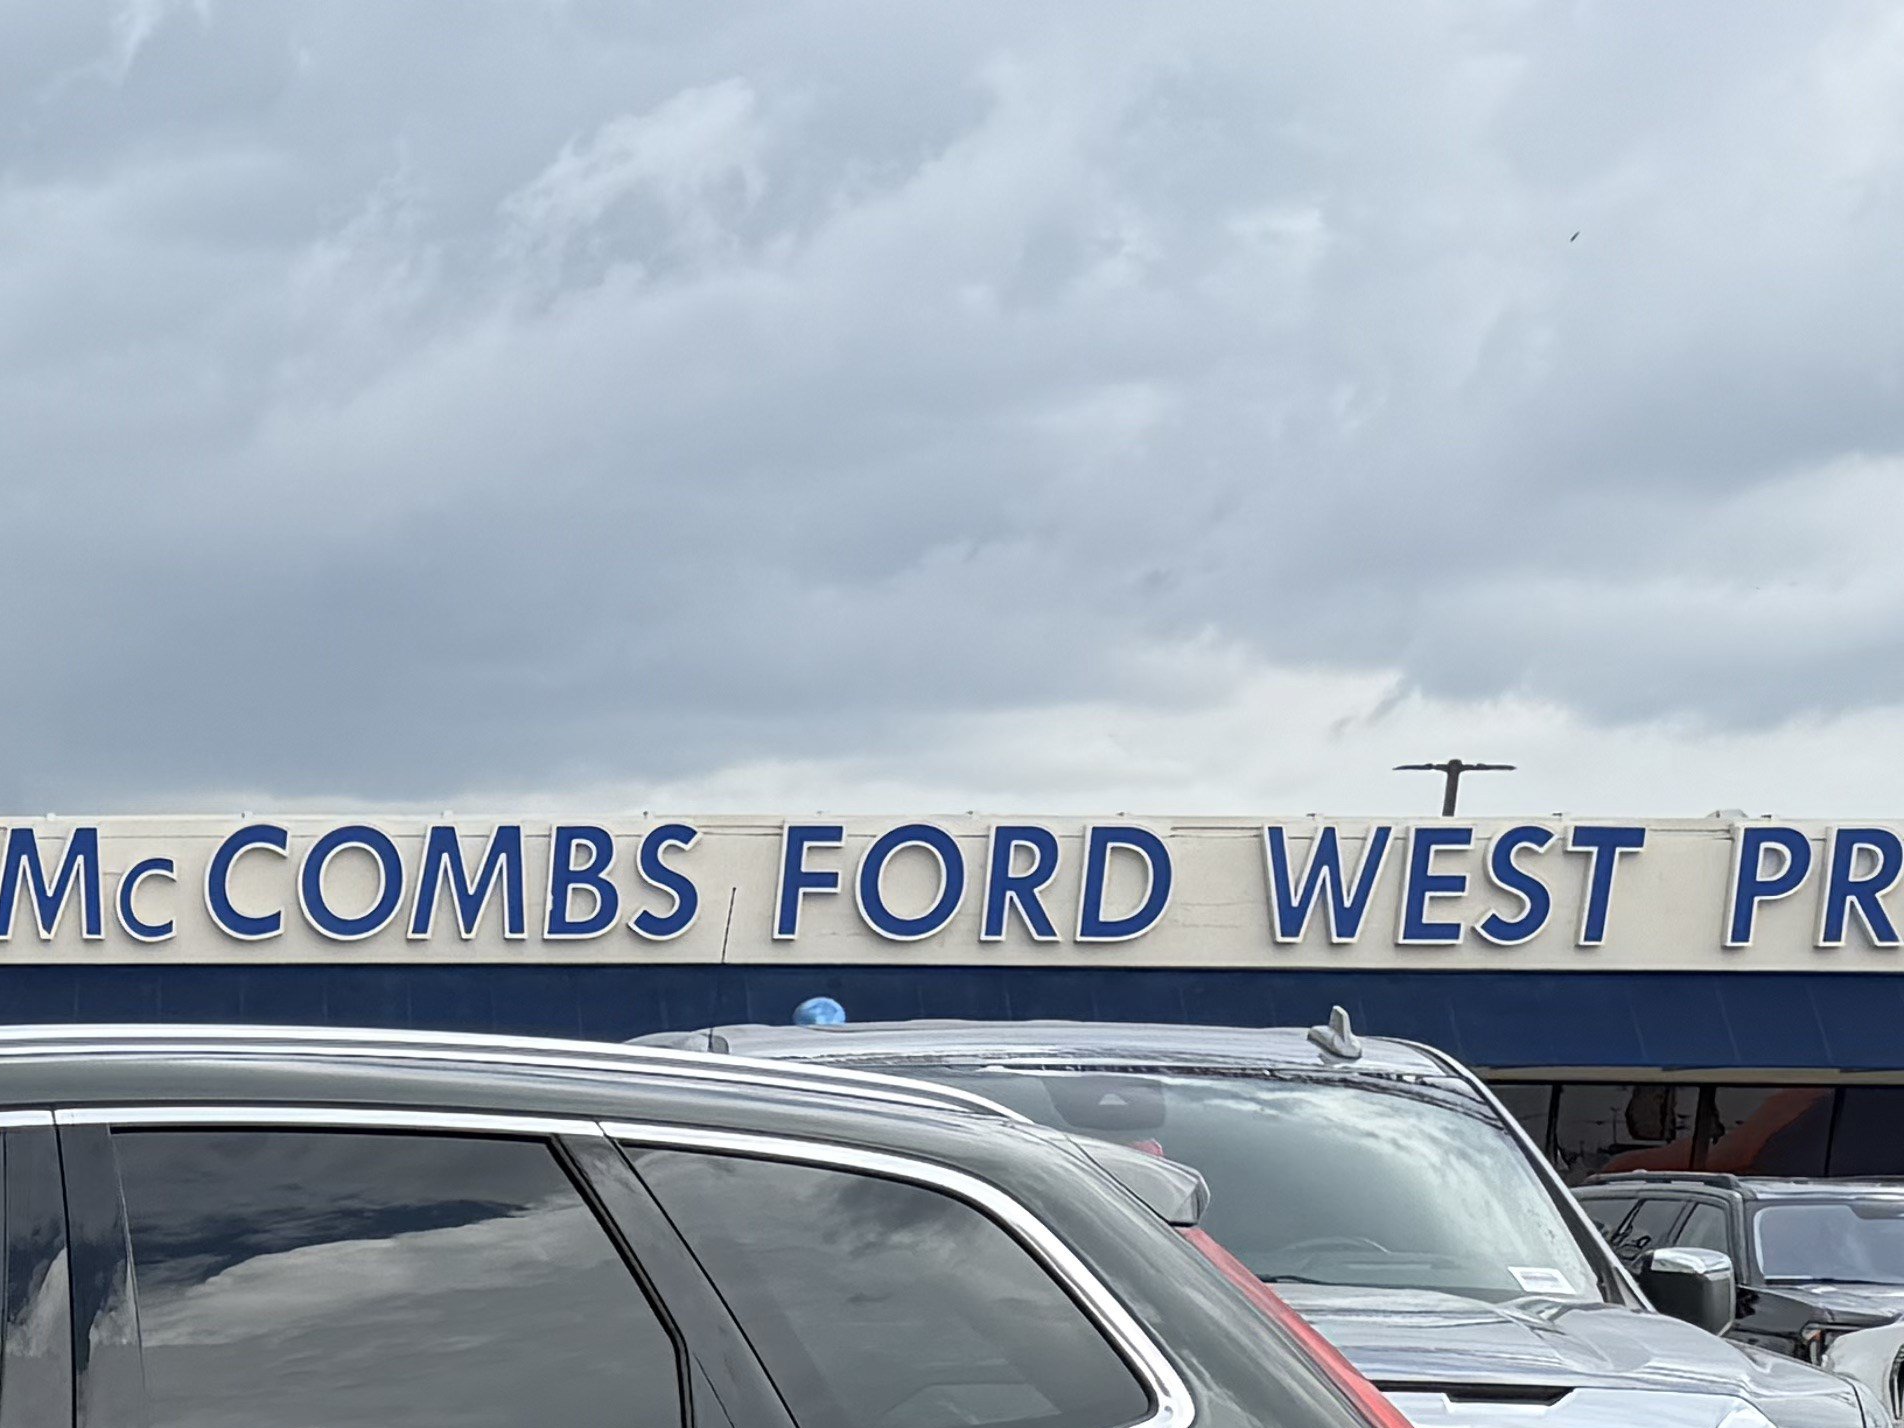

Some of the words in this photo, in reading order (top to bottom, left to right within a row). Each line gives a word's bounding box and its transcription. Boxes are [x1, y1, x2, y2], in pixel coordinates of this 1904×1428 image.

[776, 824, 1173, 940] FORD
[1267, 826, 1647, 942] WEST
[1728, 826, 1904, 944] PR
